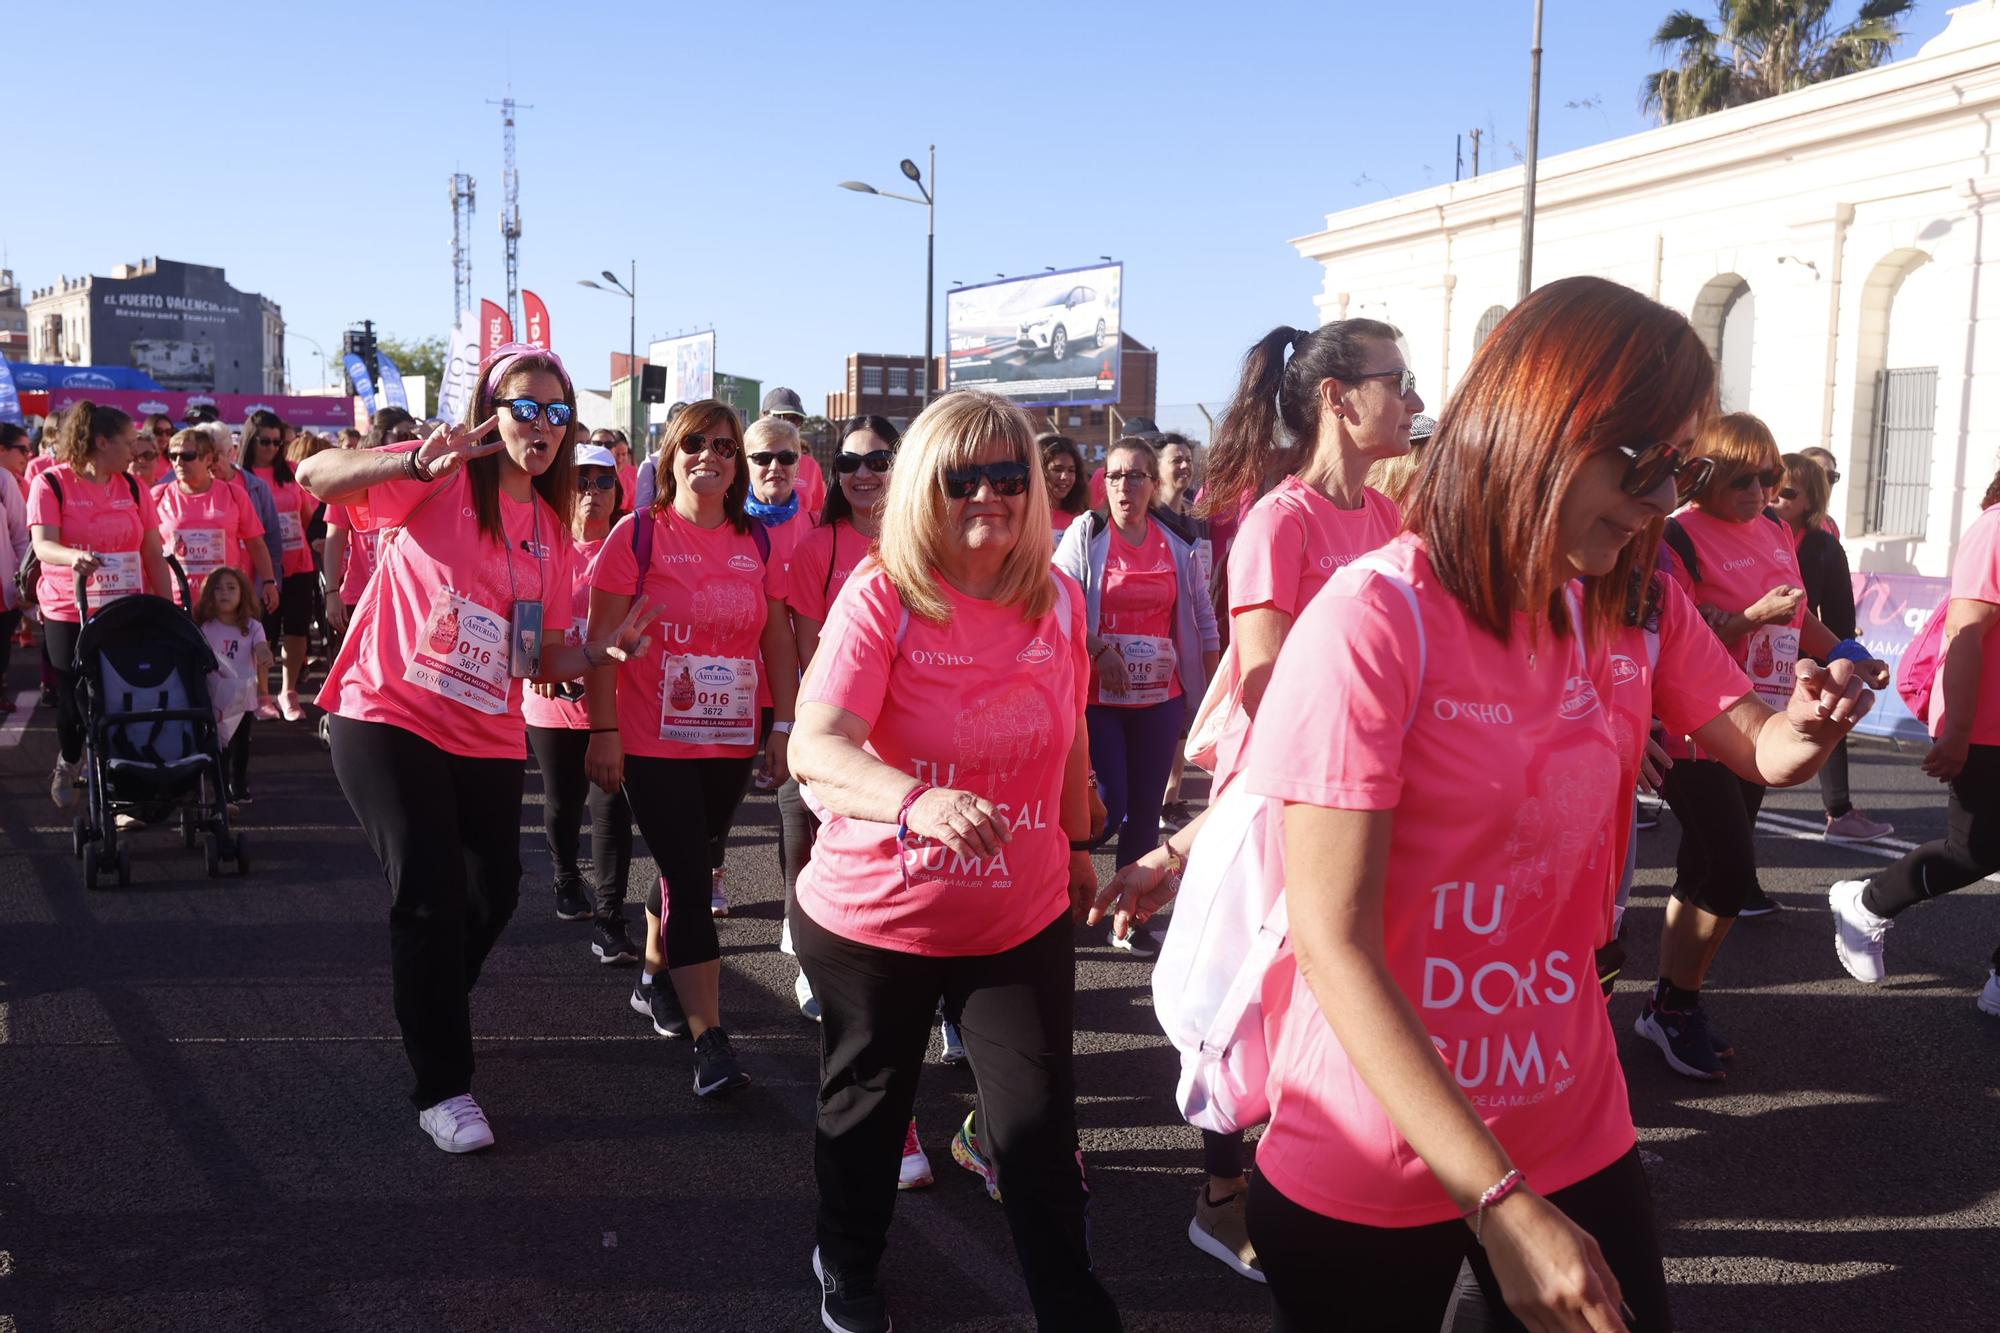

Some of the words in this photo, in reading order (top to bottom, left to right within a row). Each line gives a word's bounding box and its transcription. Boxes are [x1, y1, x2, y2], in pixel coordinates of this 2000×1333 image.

[104, 295, 117, 305] EL
[119, 293, 164, 309] PUERTO
[115, 308, 179, 320] Restaurante
[189, 546, 208, 555] 016
[96, 574, 119, 583] 016
[465, 618, 499, 640] ASTURIANA
[660, 621, 692, 644] TU
[458, 641, 491, 664] 016
[911, 649, 974, 666] OYSHO
[459, 658, 480, 674] 3671
[1127, 662, 1152, 673] 016
[416, 670, 450, 689] OYSHO
[425, 659, 455, 675] CARRERA
[454, 671, 464, 680] DE
[463, 674, 472, 682] LA
[471, 677, 489, 690] MUJER
[698, 671, 733, 681] ASTURIANA
[471, 693, 499, 710] Santander
[697, 692, 730, 705] 016
[702, 707, 723, 716] 3672
[1434, 698, 1513, 724] OYSHO
[670, 729, 700, 738] OYSHO
[911, 758, 955, 789] TU
[955, 880, 984, 888] MUJER
[991, 880, 1012, 888] 2023
[1431, 881, 1505, 935] TU
[1489, 1095, 1507, 1107] LA
